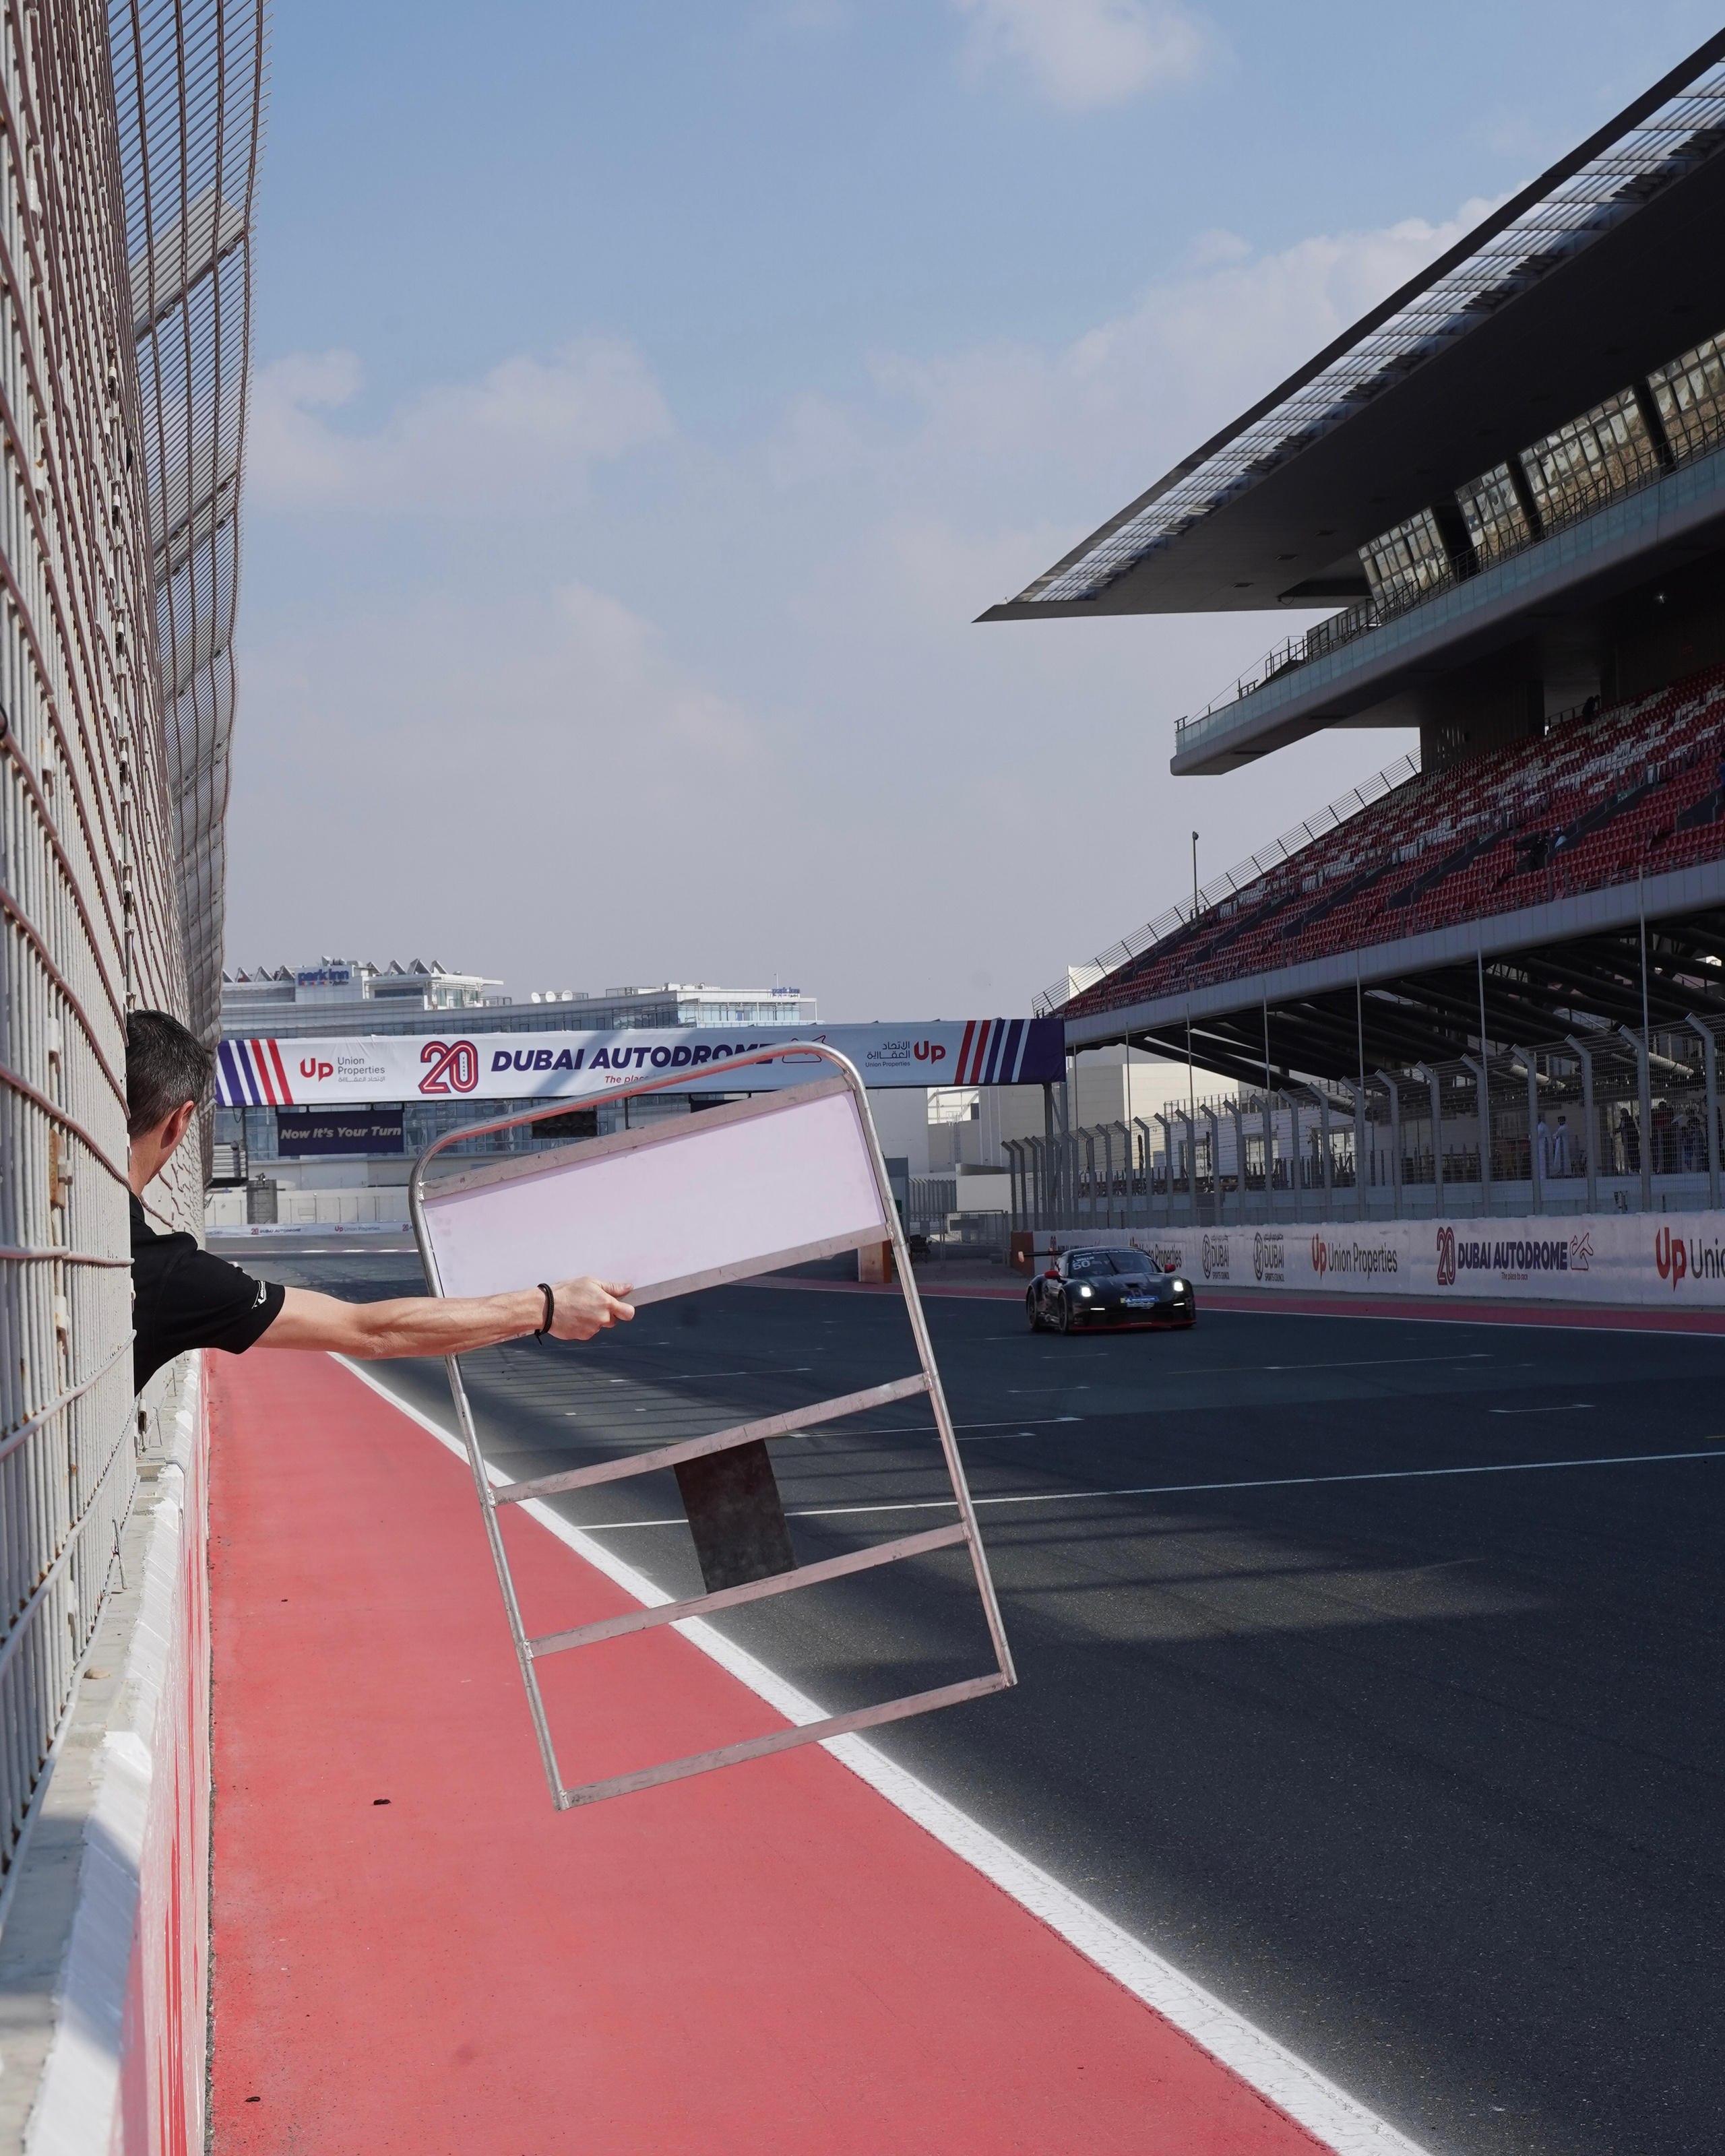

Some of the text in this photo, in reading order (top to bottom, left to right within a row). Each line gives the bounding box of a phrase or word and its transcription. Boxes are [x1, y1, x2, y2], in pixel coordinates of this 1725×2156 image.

[338, 1056, 365, 1065] Union
[338, 1066, 385, 1075] Properties
[418, 1040, 478, 1093] 20
[491, 1048, 584, 1072] DUBAI
[605, 1075, 648, 1085] The plac
[280, 1129, 311, 1139] Now
[337, 1127, 368, 1137] Your
[371, 1126, 402, 1137] Turn
[1073, 1260, 1091, 1270] 50
[1211, 1244, 1230, 1267] DUBAI
[1263, 1244, 1284, 1268] DUBAI
[1328, 1242, 1398, 1279] Union Properties
[1437, 1226, 1455, 1286] 20
[1457, 1242, 1491, 1269] DUBAI
[1493, 1240, 1568, 1270] AUTODROME
